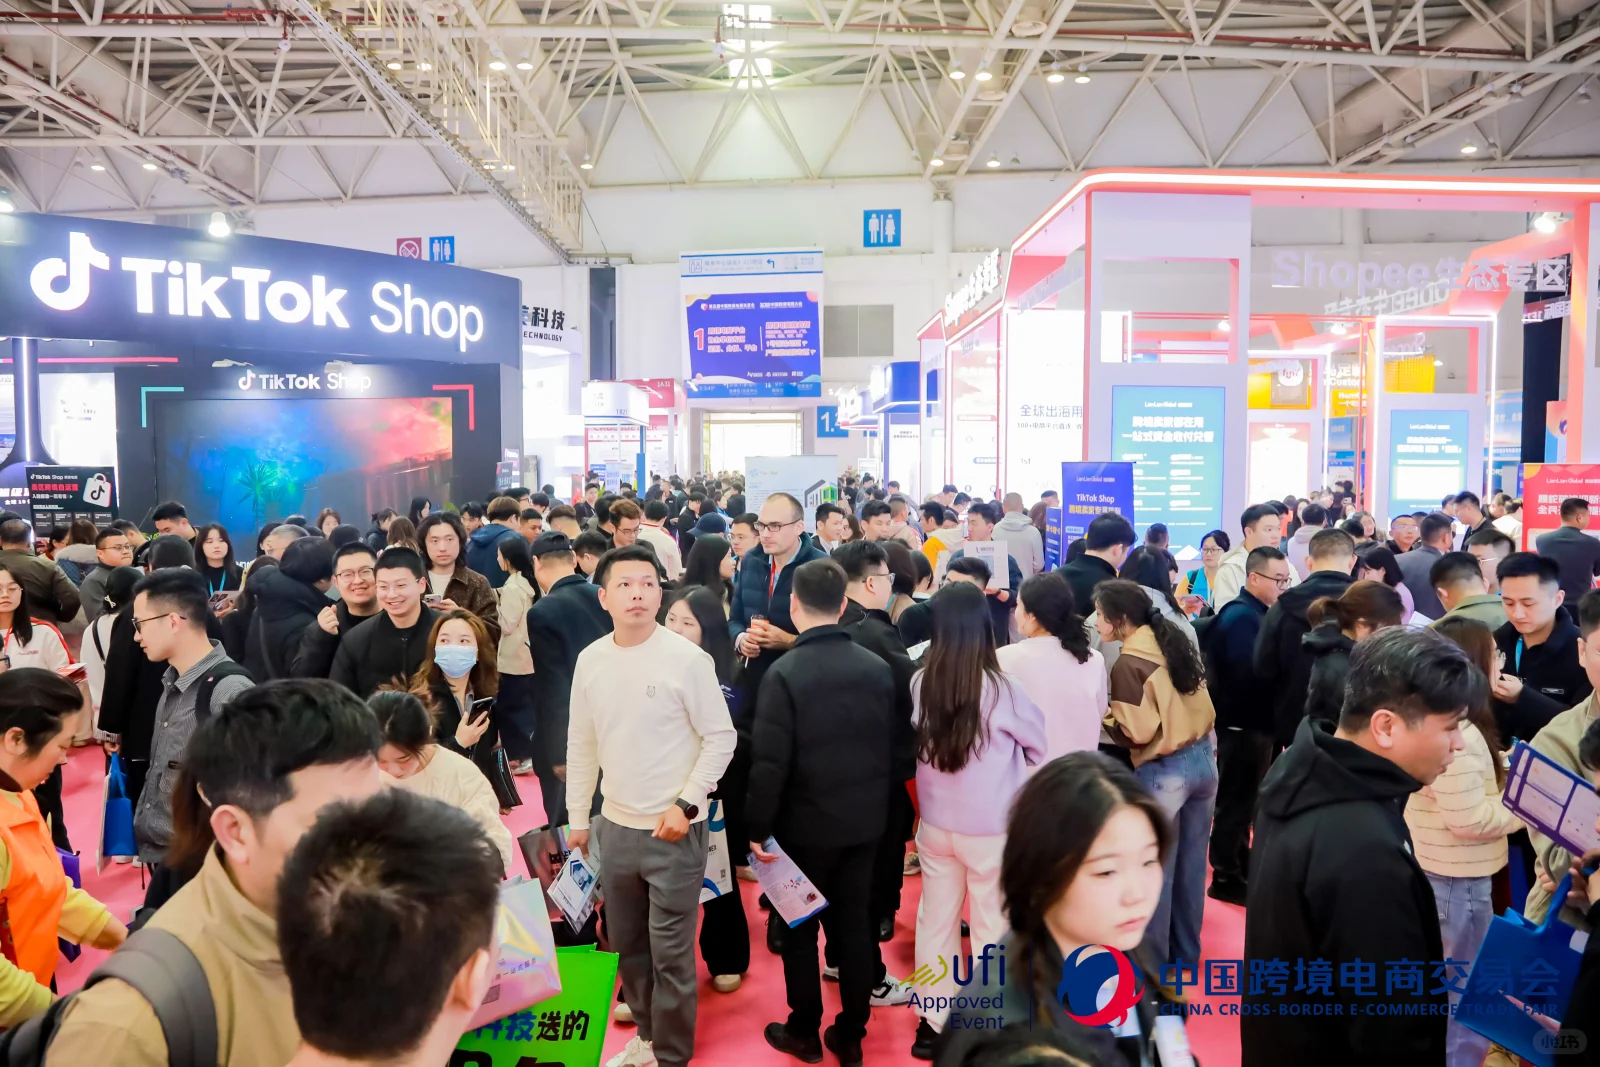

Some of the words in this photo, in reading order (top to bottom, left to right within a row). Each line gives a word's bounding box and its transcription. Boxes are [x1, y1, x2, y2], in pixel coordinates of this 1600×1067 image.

[1274, 250, 1567, 295] Shopee生态专区
[121, 256, 350, 329] TikTok
[370, 281, 484, 352] Shop
[258, 373, 321, 390] TikTok
[326, 371, 372, 393] Shop
[1076, 494, 1098, 502] TikTok
[1098, 494, 1115, 505] Shop
